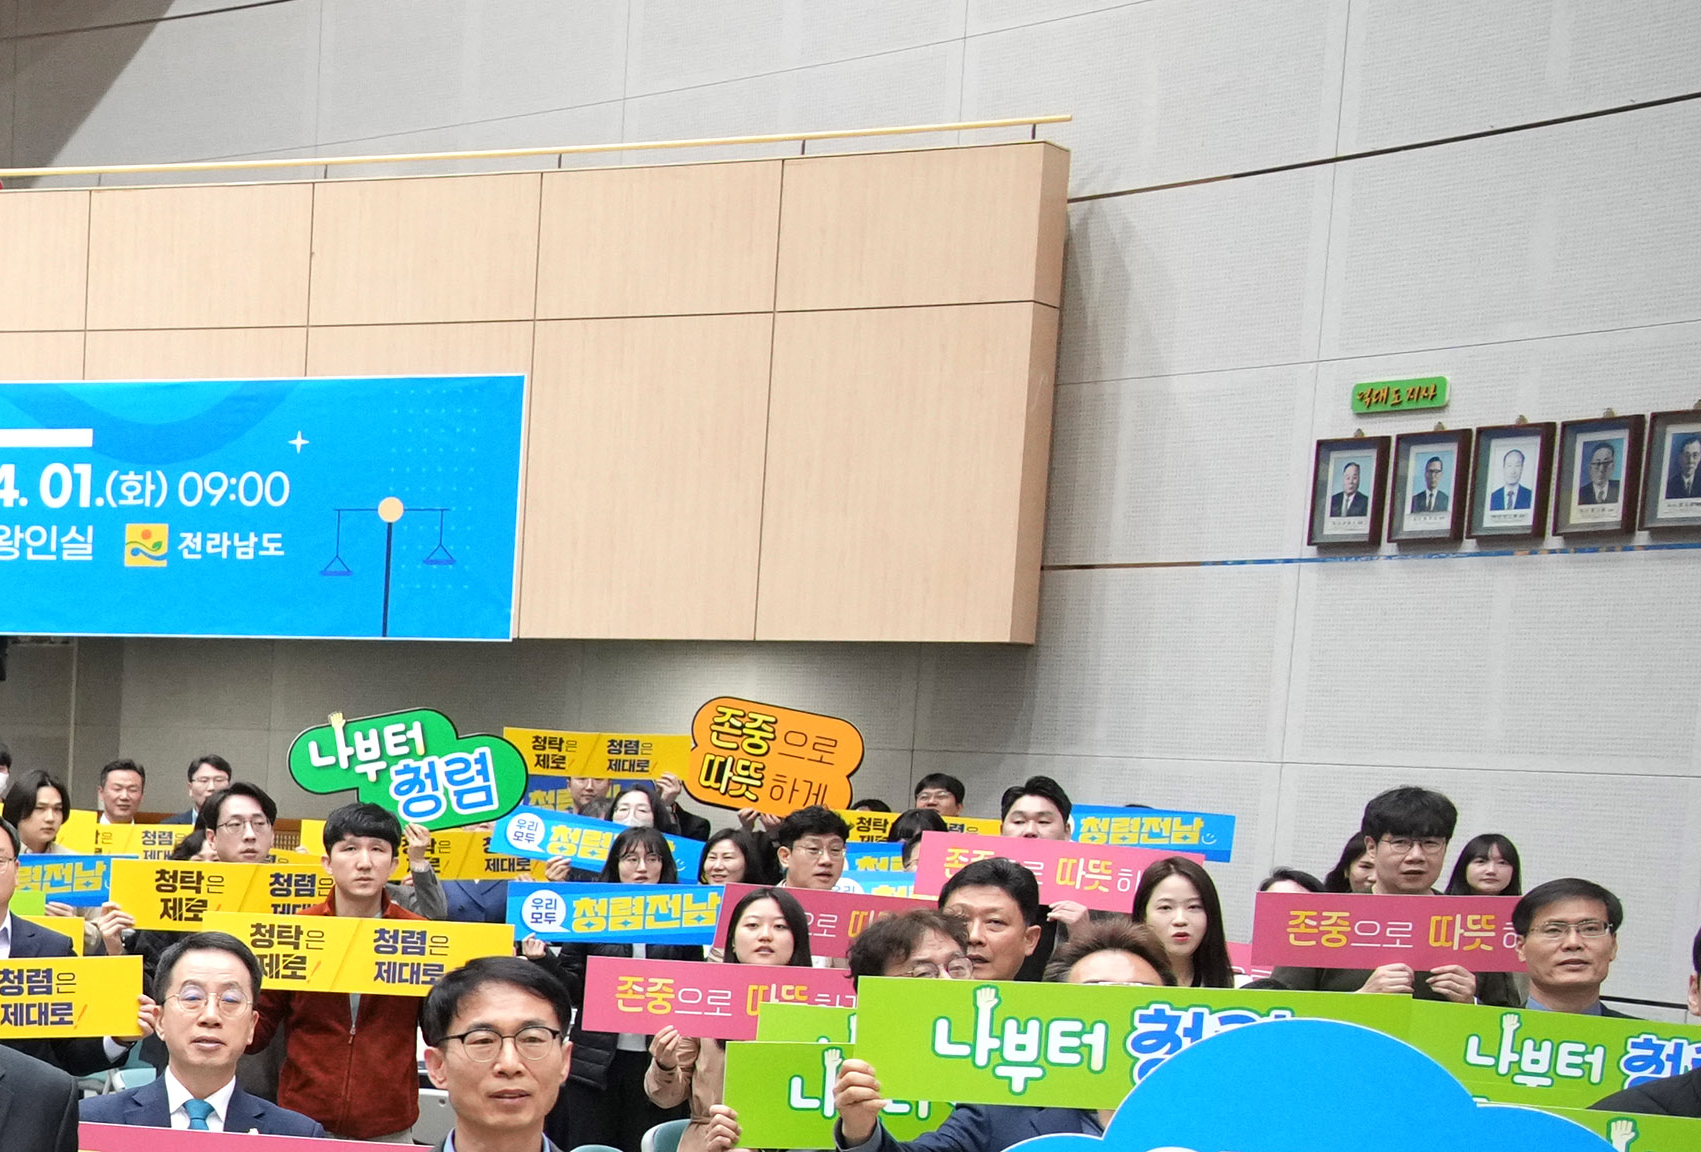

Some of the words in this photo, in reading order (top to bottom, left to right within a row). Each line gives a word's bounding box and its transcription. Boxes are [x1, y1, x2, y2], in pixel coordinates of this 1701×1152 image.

[178, 470, 291, 507] 09:00
[177, 530, 286, 560] 전라남도
[308, 712, 425, 782] 나부터
[531, 735, 579, 753] 청탁은
[606, 738, 653, 755] 청렴은
[709, 705, 838, 766] 존중으로
[389, 747, 499, 822] 청렴
[141, 830, 185, 846] 청렴은
[513, 830, 536, 843] 모두
[515, 818, 539, 833] 우리
[856, 816, 889, 834] 청탁
[1079, 816, 1205, 845] 청렴전남
[546, 824, 612, 861] 청렴
[17, 861, 107, 894] 렴전남
[155, 868, 225, 895] 청탁은
[269, 872, 334, 898] 청렴은
[1056, 857, 1141, 894] 따뜻하
[530, 912, 557, 925] 모두
[531, 898, 557, 912] 우리
[572, 892, 721, 933] 청렴전남
[249, 923, 325, 951] 청탁은
[373, 928, 450, 957] 청렴은
[1286, 910, 1414, 949] 존중으로
[1428, 913, 1518, 951] 따뜻
[373, 961, 445, 985] 제대로
[615, 975, 733, 1017] 존중으로
[0, 1001, 88, 1030] 제대로!
[933, 986, 1108, 1094] 나부터
[1465, 1012, 1605, 1088] 나부터
